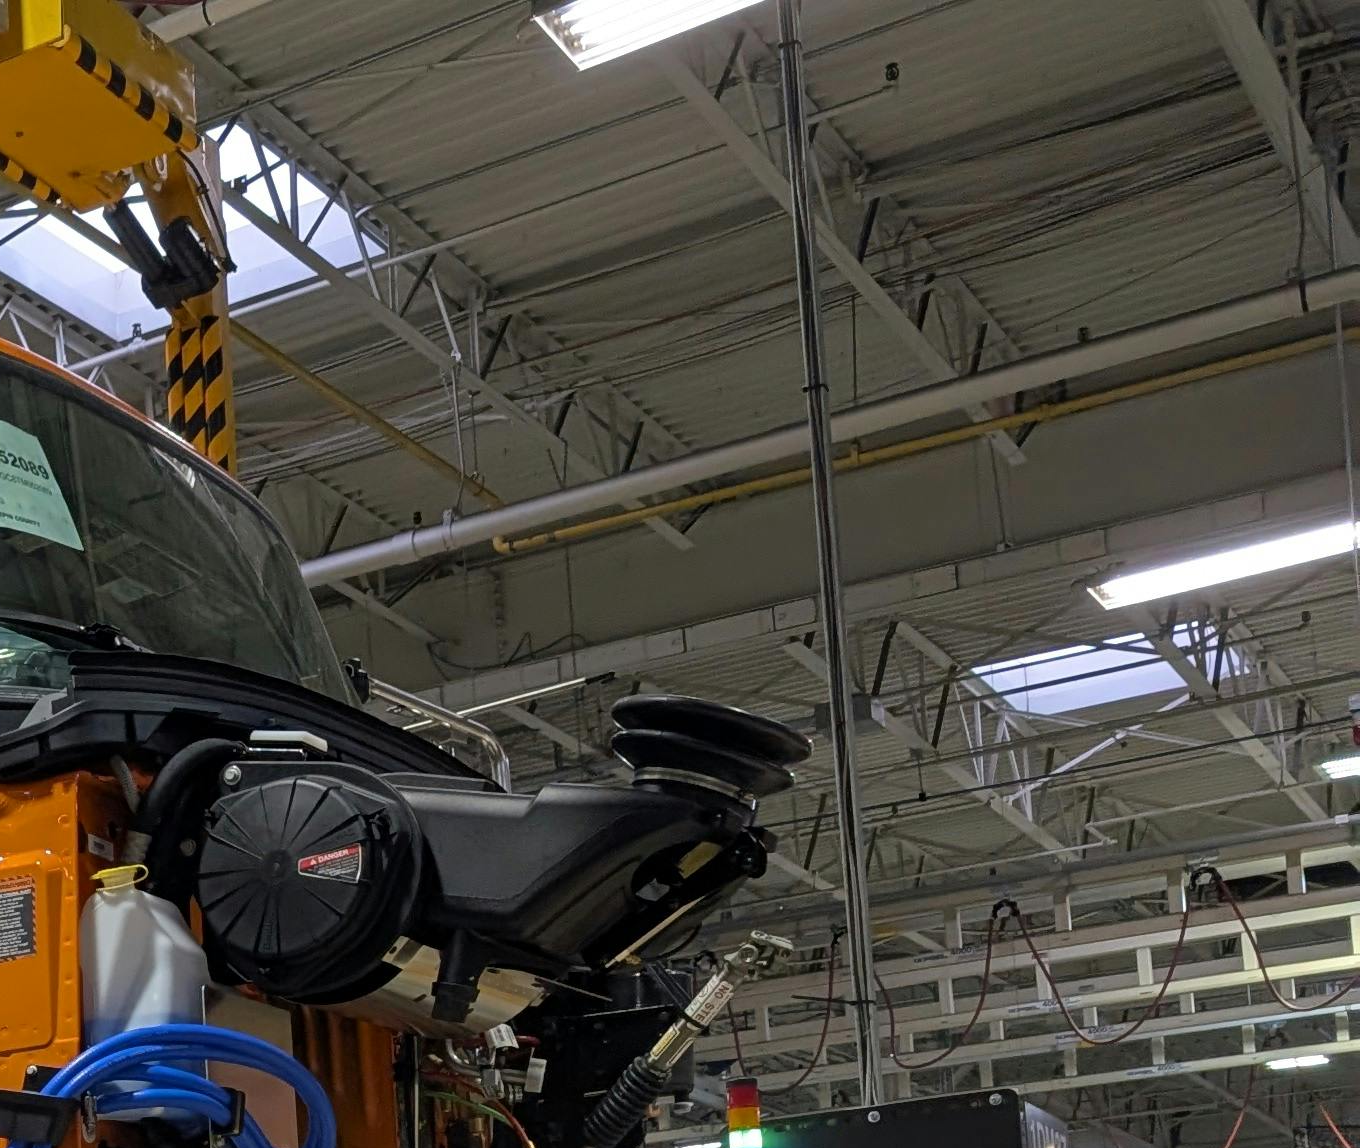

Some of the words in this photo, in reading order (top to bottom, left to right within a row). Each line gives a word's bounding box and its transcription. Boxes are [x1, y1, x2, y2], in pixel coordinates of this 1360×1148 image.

[318, 849, 349, 863] DANGER
[714, 984, 730, 1000] NO
[695, 1002, 715, 1021] STE
